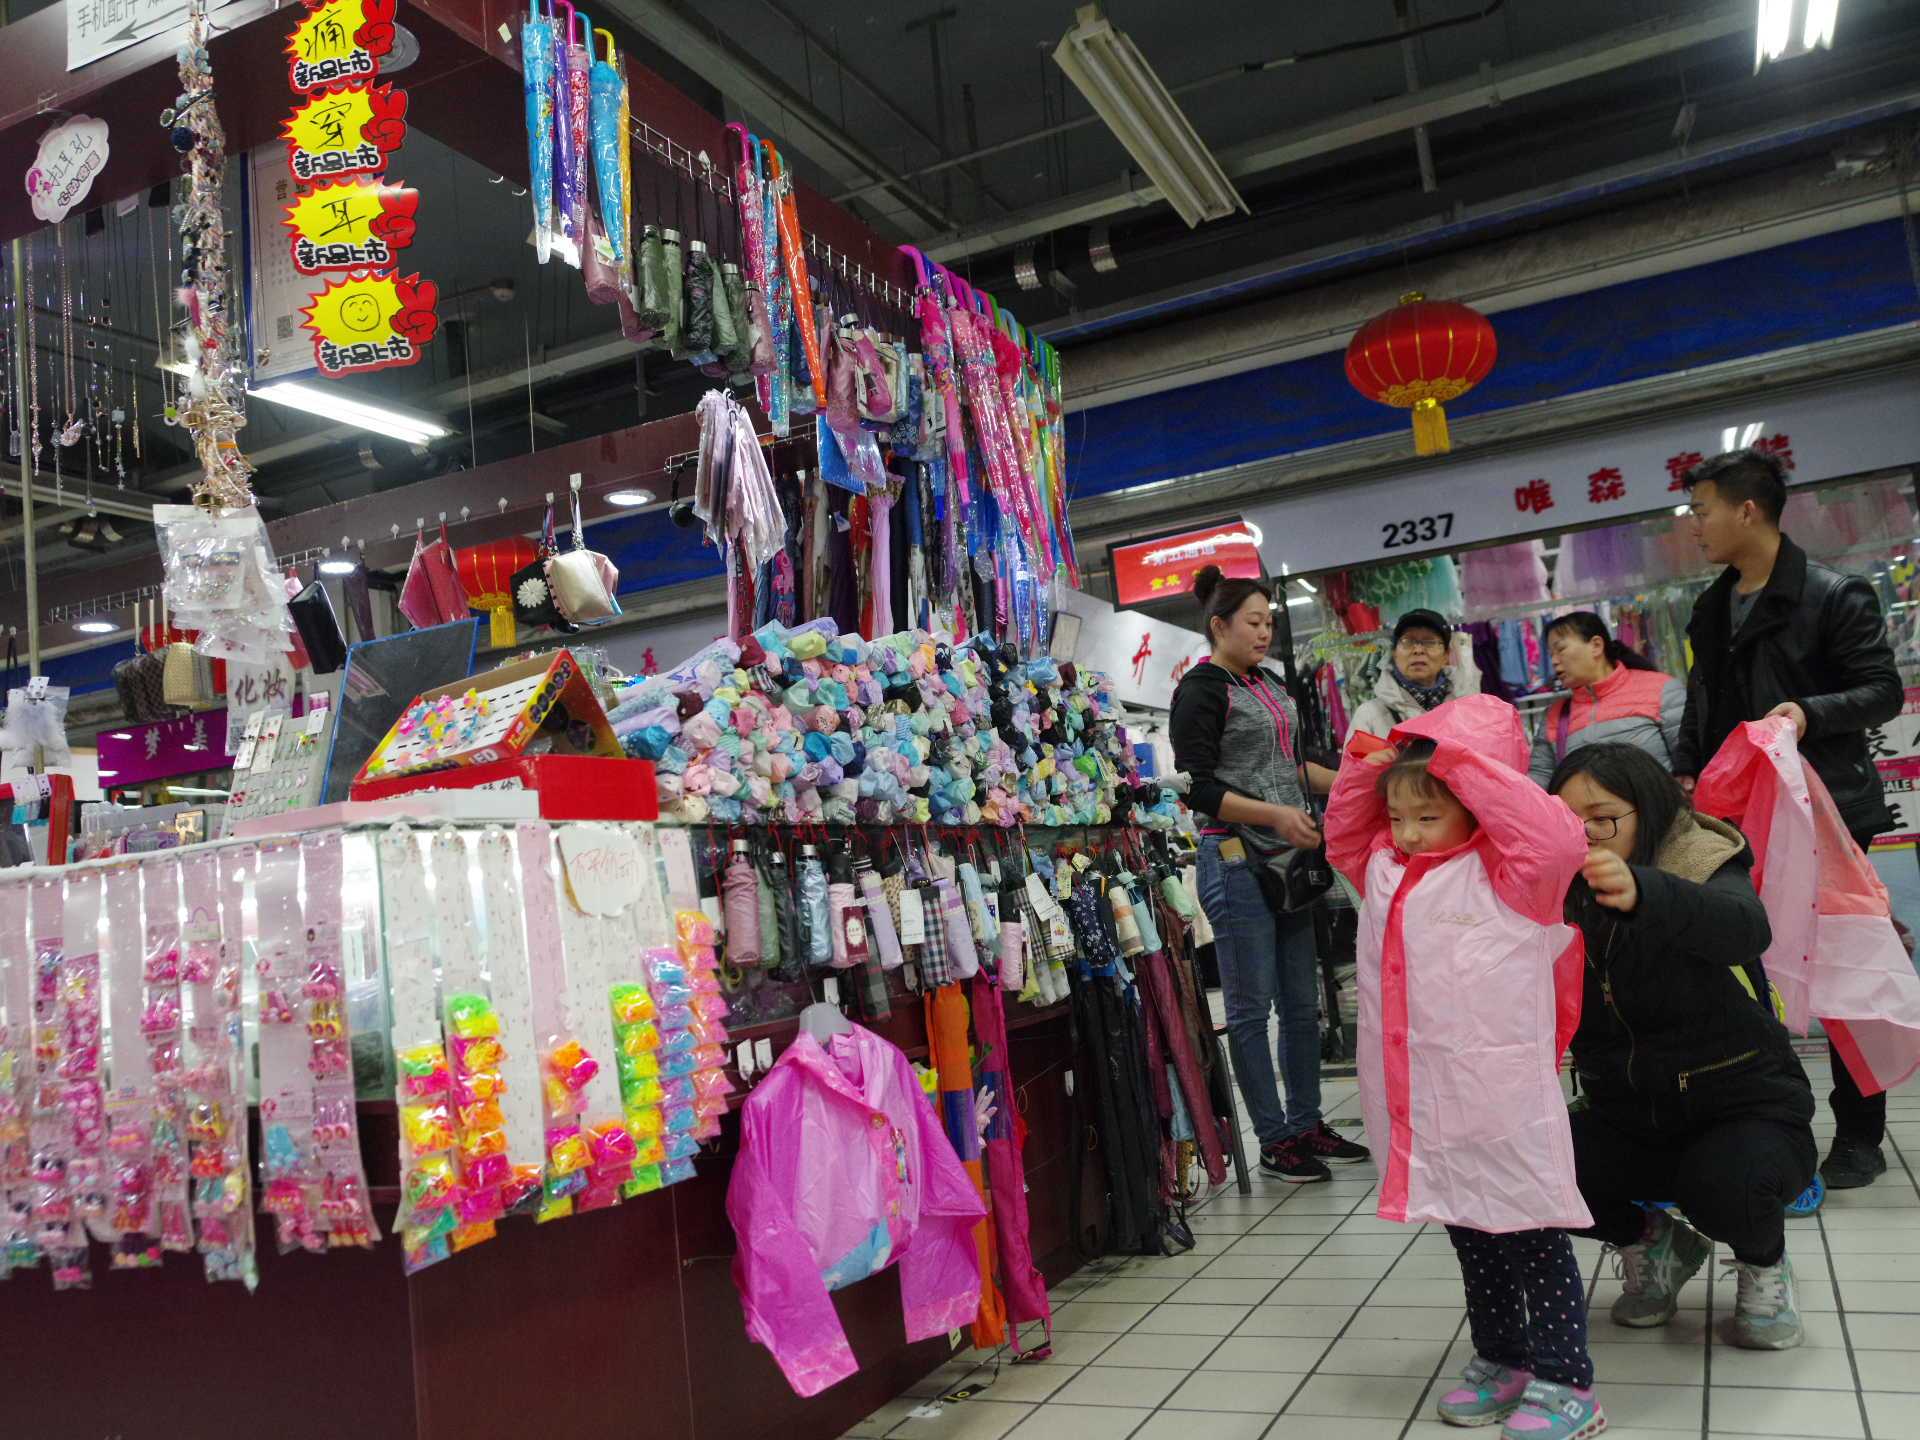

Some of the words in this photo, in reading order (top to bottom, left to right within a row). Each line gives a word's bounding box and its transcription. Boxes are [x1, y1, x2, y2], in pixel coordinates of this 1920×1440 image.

[294, 49, 371, 87] 新品上市
[310, 101, 352, 149] 穿
[294, 143, 379, 178] 新品上市
[320, 197, 367, 237] 耳
[298, 238, 388, 268] 新品上市
[320, 335, 412, 370] 新品上市
[1382, 512, 1454, 549] 2337
[235, 667, 288, 706] 化妆
[470, 748, 499, 765] LED
